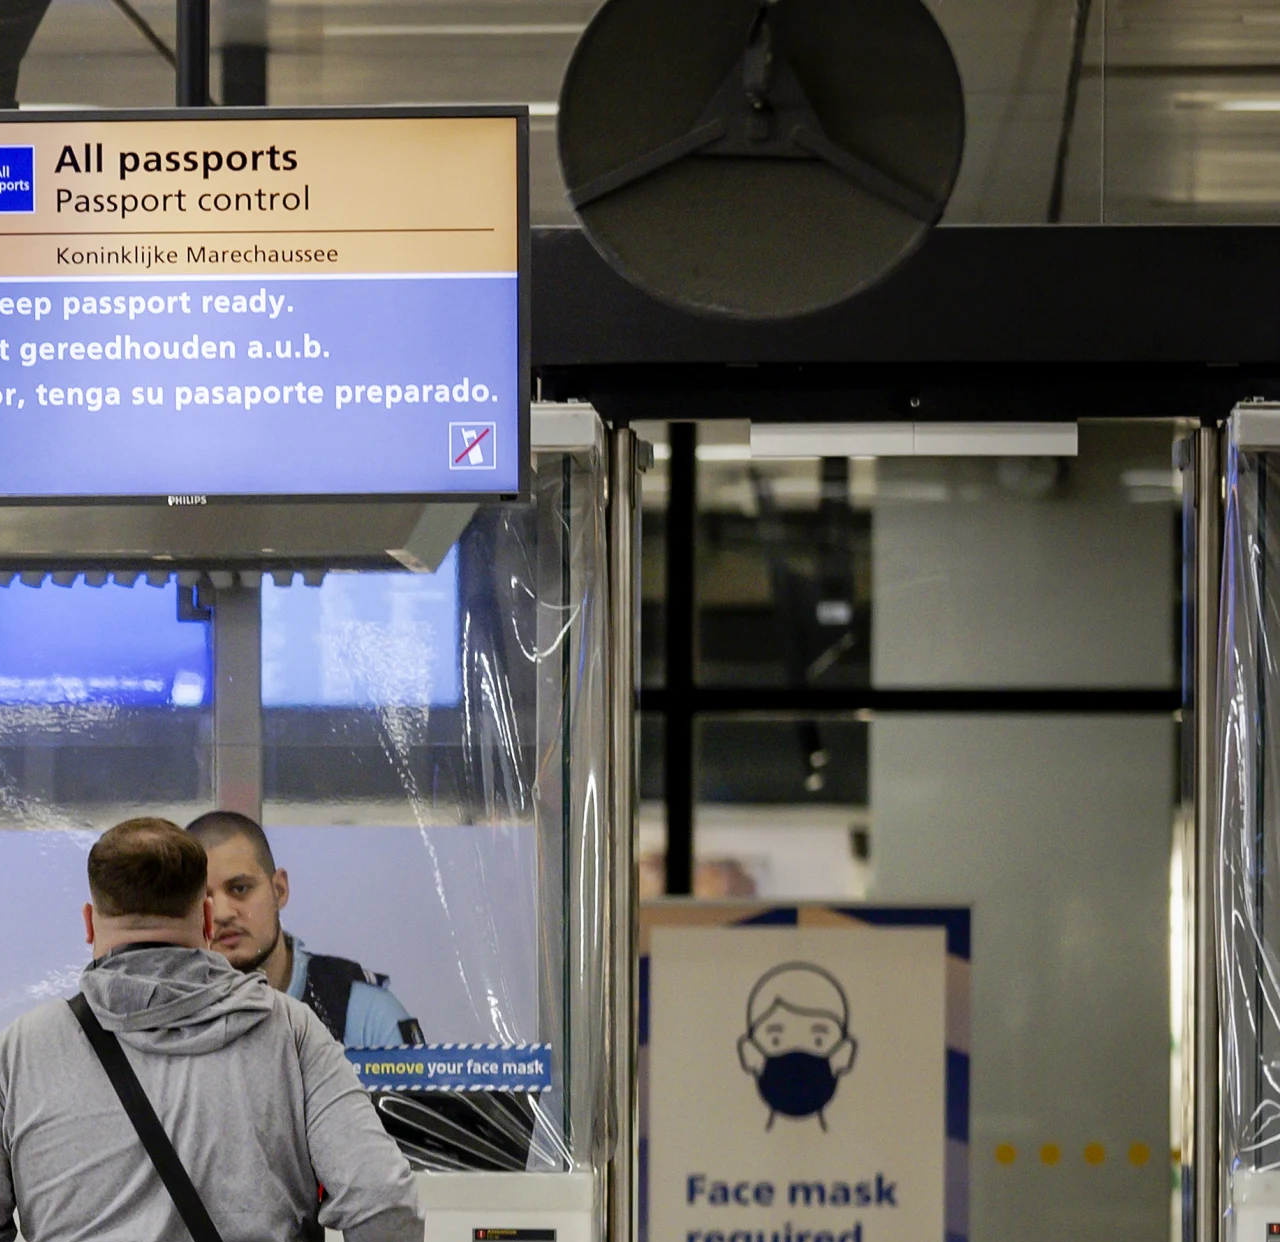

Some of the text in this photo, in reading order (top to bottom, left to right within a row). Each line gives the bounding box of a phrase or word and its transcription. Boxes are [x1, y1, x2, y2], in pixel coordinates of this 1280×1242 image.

[55, 143, 297, 180] All passports
[57, 185, 308, 218] Passport control
[57, 245, 338, 268] Koninklijke Marechaussee
[62, 292, 190, 320] passport
[203, 288, 293, 318] ready.
[20, 336, 235, 368] gereedhouden
[248, 334, 329, 358] a.u.b.
[36, 384, 120, 411] tenga
[132, 387, 163, 405] su
[176, 382, 323, 410] pasaporte
[336, 378, 497, 409] preparado.
[168, 496, 207, 506] PHILIPS
[365, 1062, 424, 1075] remove
[428, 1062, 463, 1078] your
[467, 1060, 498, 1074] face
[503, 1059, 543, 1075] mask
[688, 1175, 895, 1208] Face mask
